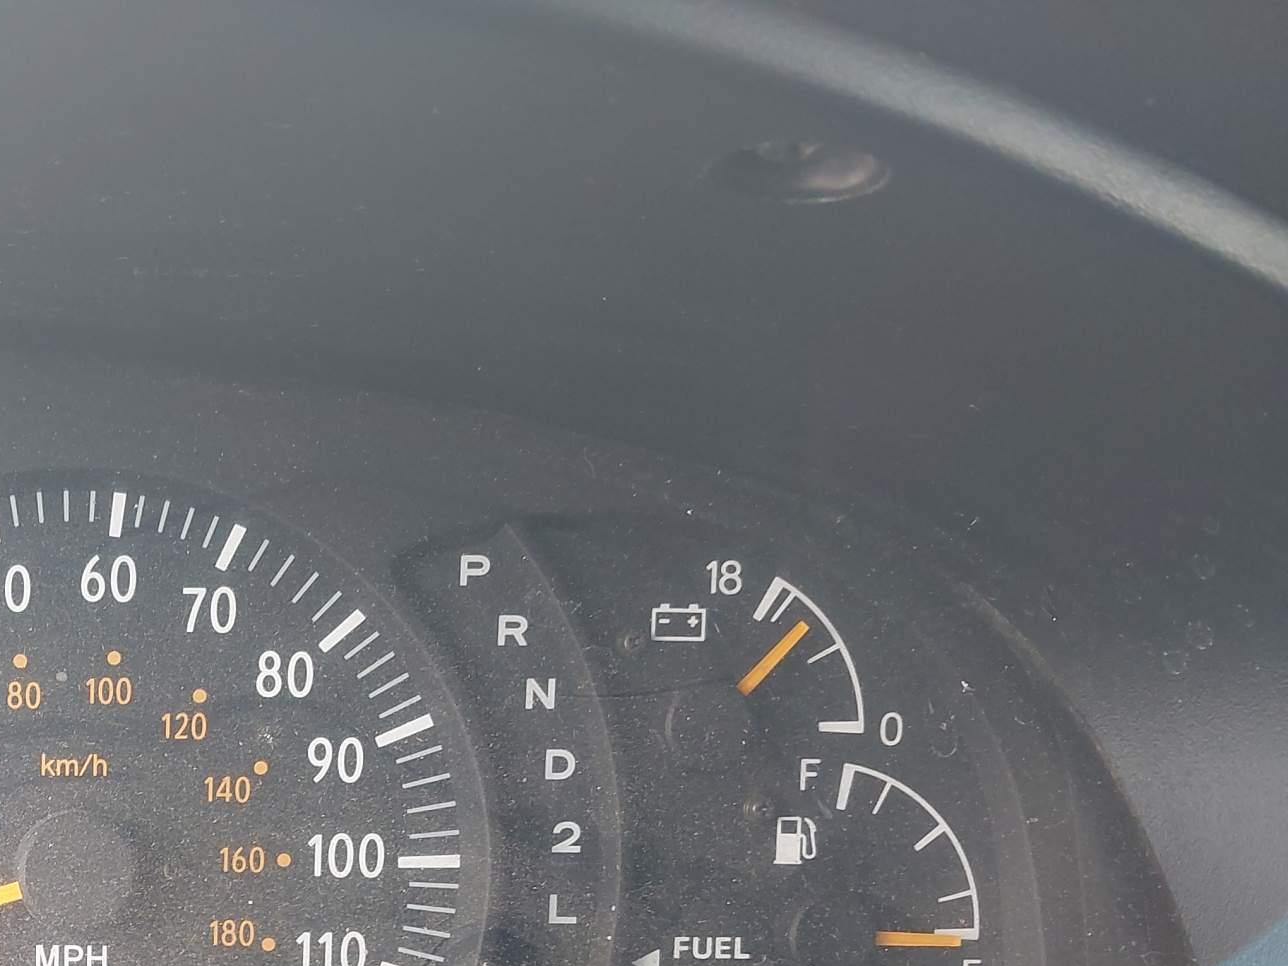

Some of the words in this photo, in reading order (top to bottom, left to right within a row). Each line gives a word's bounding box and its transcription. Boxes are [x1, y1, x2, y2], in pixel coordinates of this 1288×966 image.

[81, 555, 136, 602] 60
[460, 555, 490, 586] P
[707, 560, 742, 595] 18
[183, 586, 236, 633] 70
[498, 615, 528, 646] R
[256, 651, 313, 697] 80
[7, 680, 42, 710] 80
[87, 675, 133, 705] 100
[526, 678, 556, 709] N
[162, 711, 208, 742] 120
[880, 712, 903, 746] 0
[40, 753, 109, 777] km/h
[308, 737, 363, 783] 90
[545, 749, 576, 780] D
[800, 759, 821, 790] F
[205, 775, 252, 804] 140
[552, 822, 581, 853] 2
[221, 846, 268, 874] 160
[308, 833, 384, 878] 100
[549, 894, 577, 924] L
[210, 919, 256, 948] 180
[674, 936, 750, 959] FUEL
